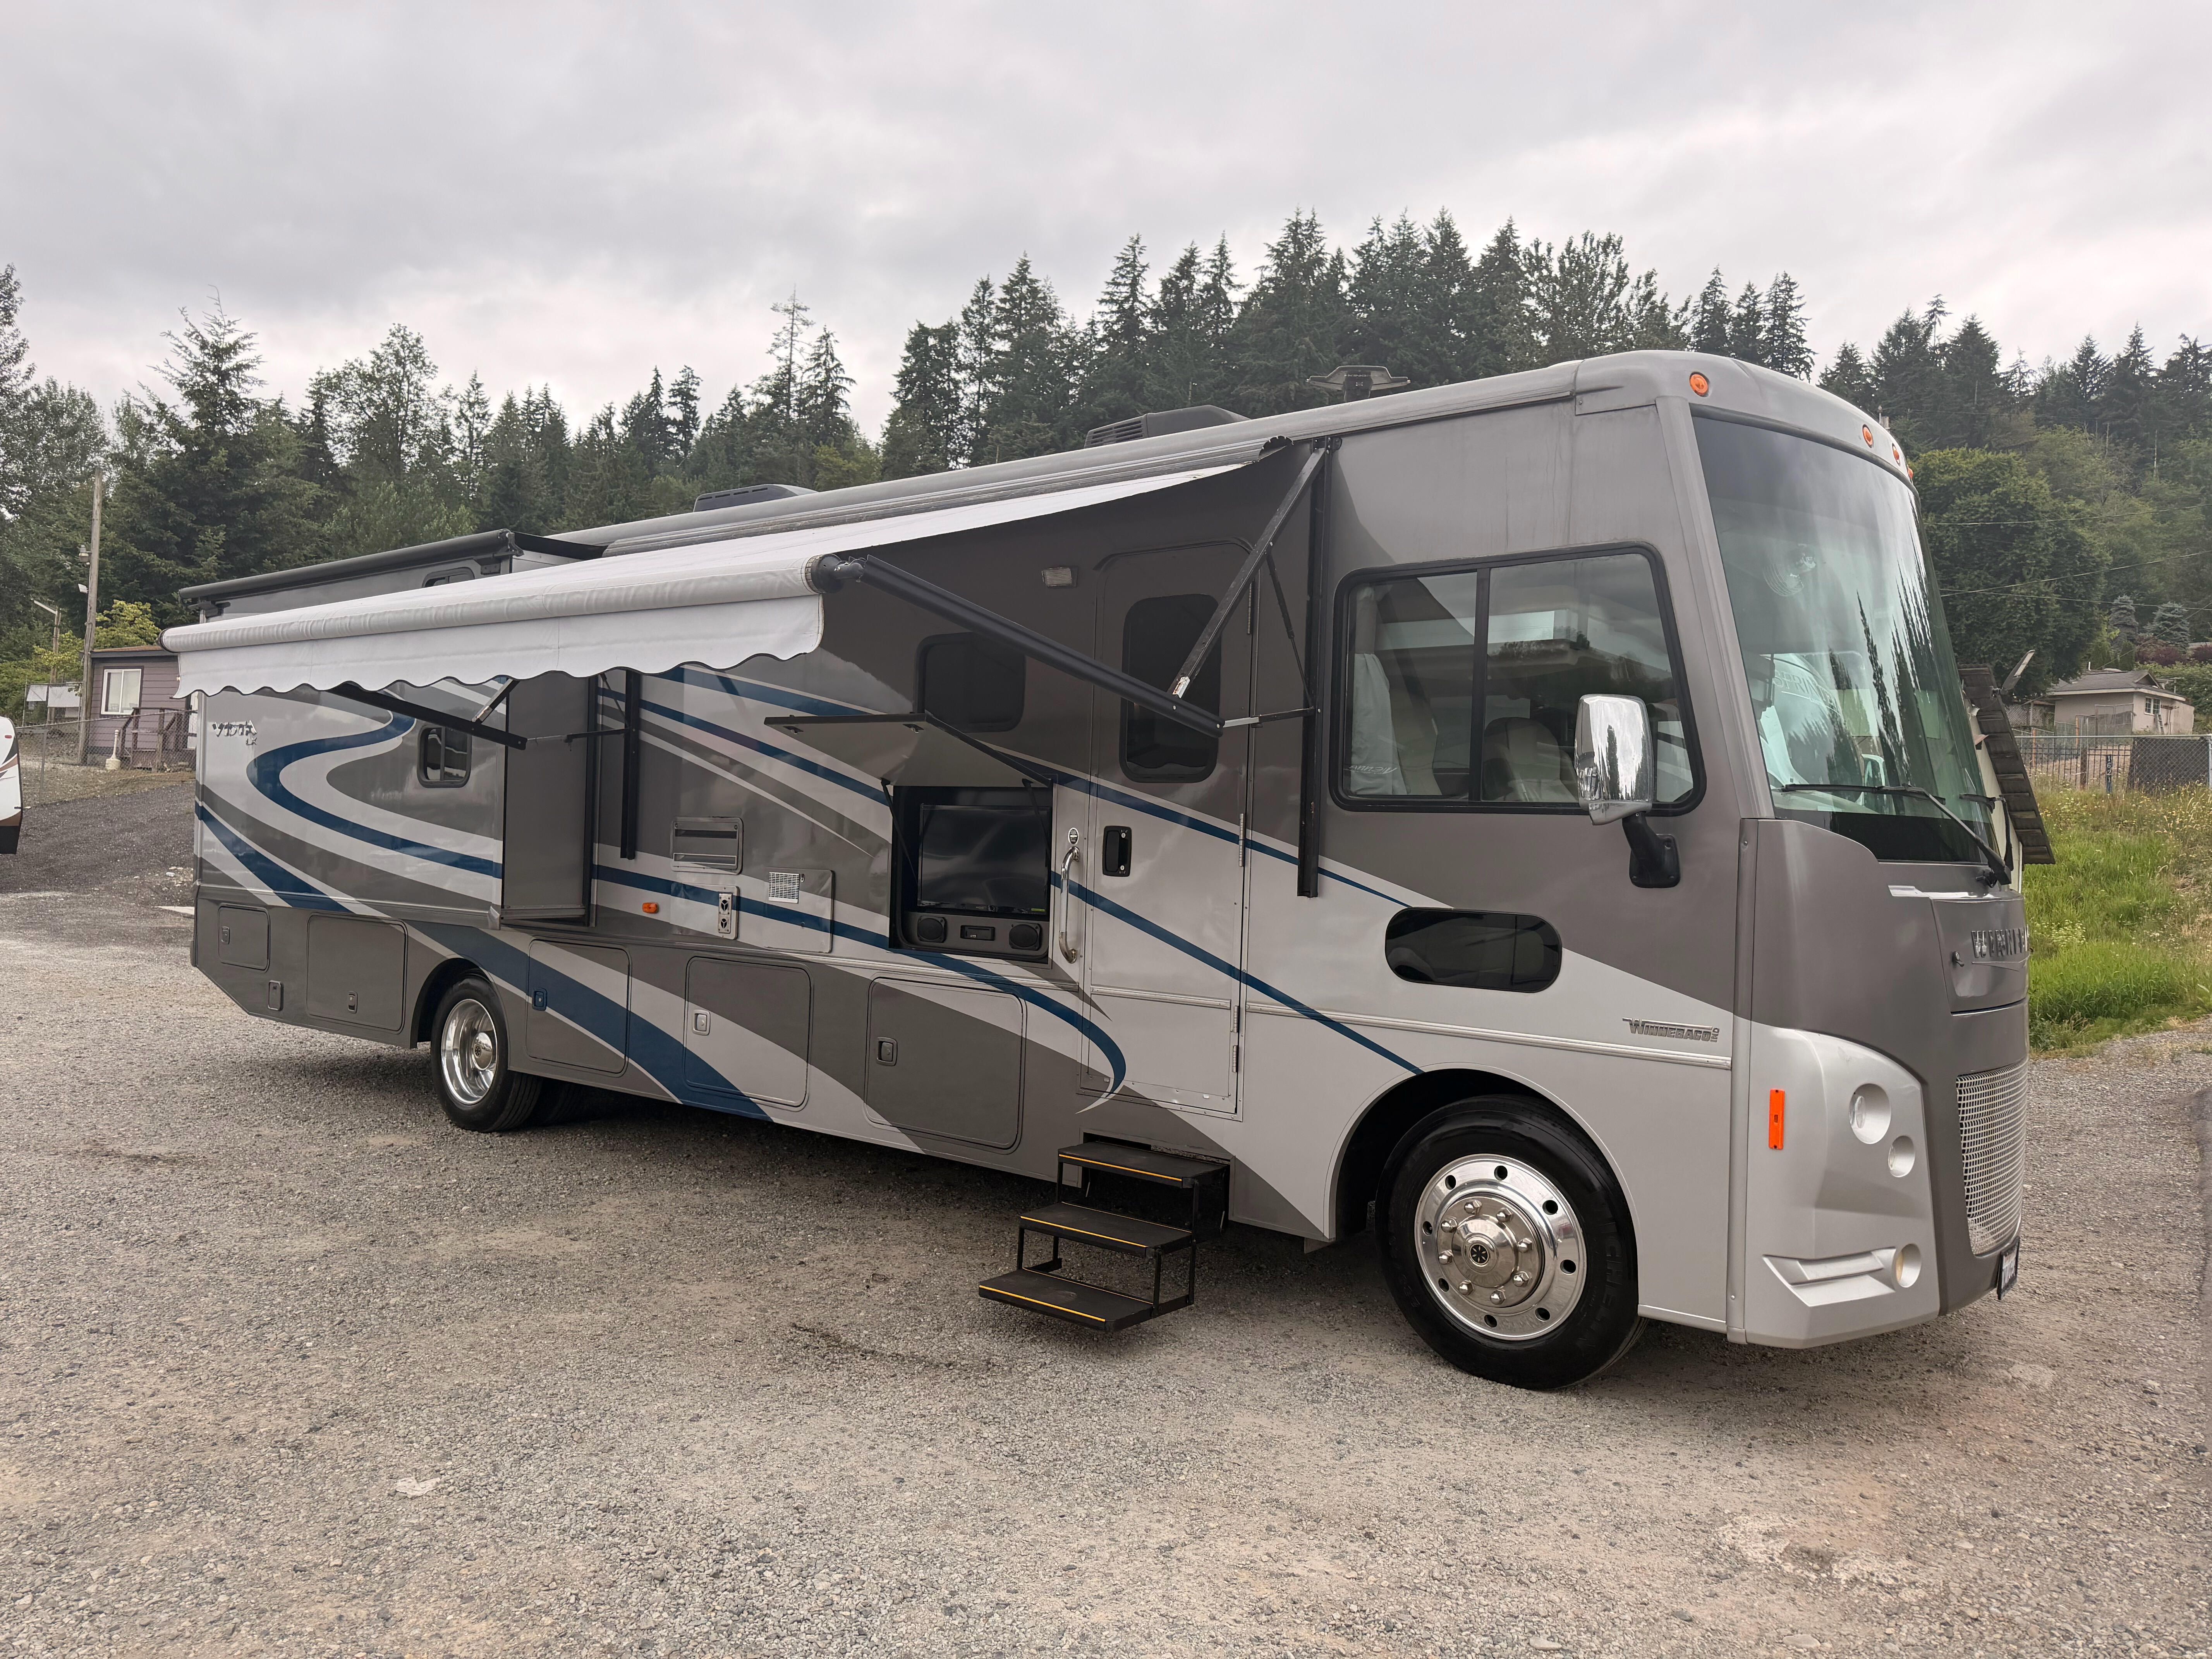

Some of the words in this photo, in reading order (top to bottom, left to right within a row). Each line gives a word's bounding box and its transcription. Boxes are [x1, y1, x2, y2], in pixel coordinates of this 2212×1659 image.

[212, 720, 257, 737] VISTA
[1623, 1018, 1712, 1042] WINNEBAGO
[1710, 1027, 1720, 1042] IND
